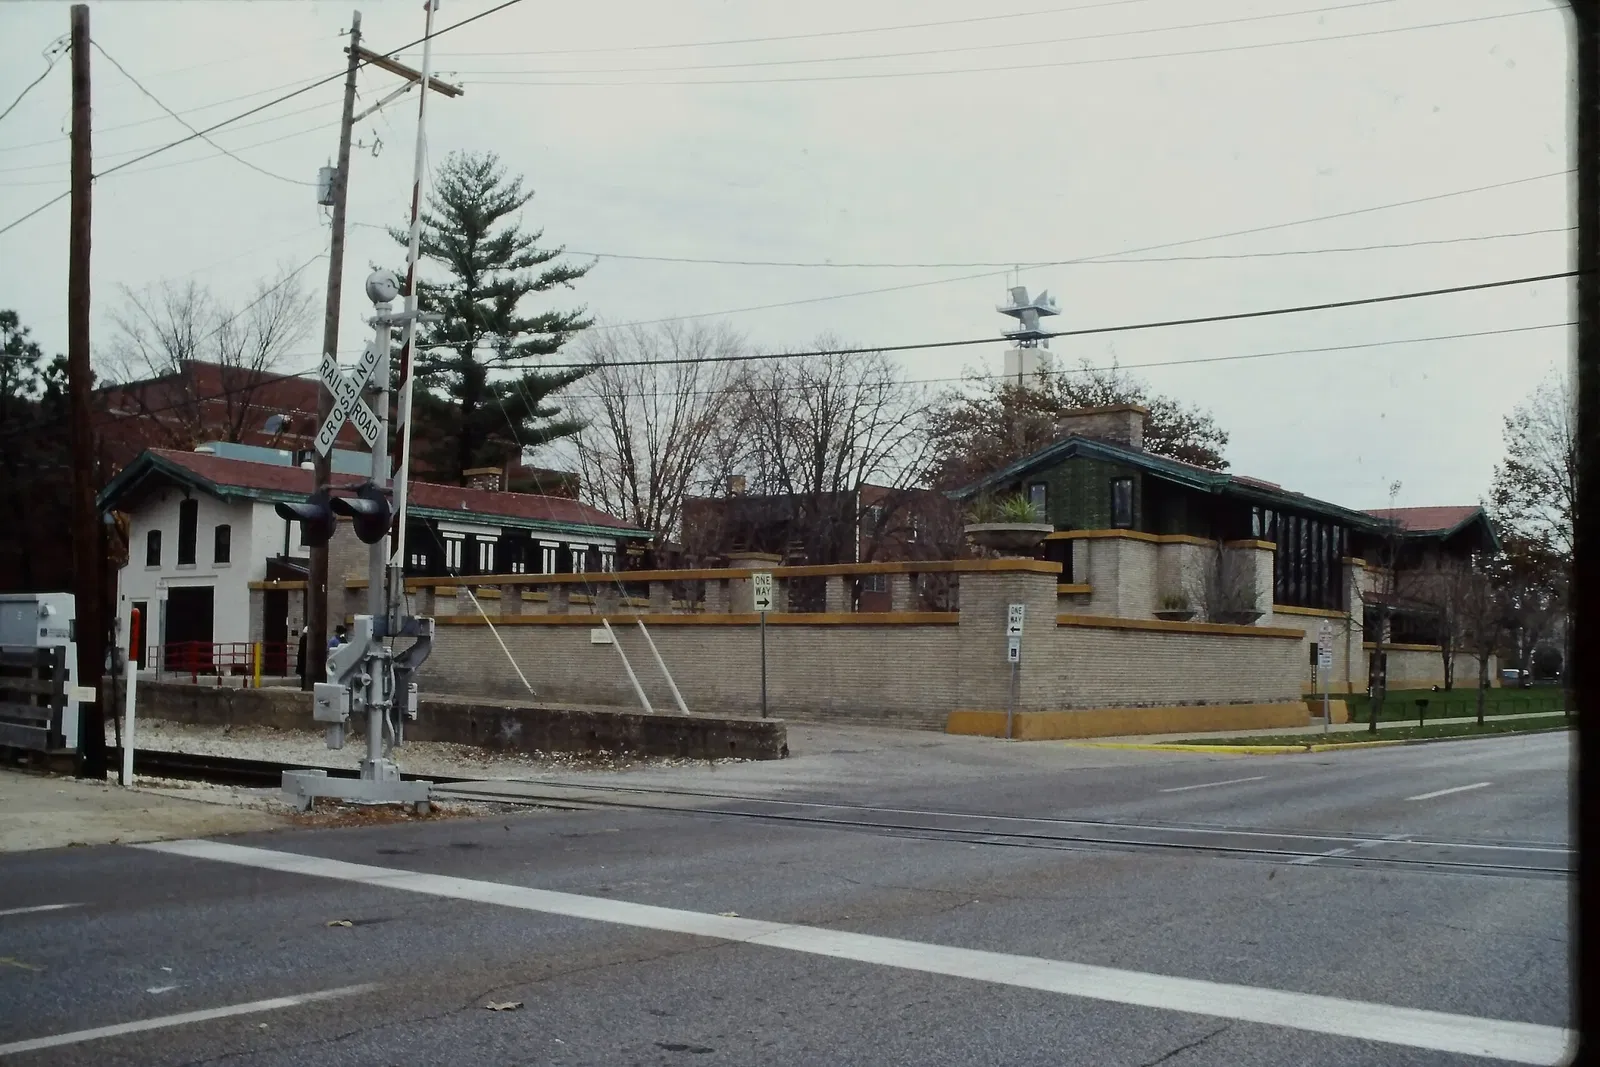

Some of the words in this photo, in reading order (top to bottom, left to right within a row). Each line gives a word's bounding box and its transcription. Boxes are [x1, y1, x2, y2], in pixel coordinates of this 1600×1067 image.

[319, 359, 343, 396] RAIL
[351, 402, 379, 441] ROAD
[320, 350, 375, 446] CROSSING
[755, 575, 771, 586] ONE
[755, 586, 771, 596] WAY
[1010, 606, 1022, 615] ONE
[1010, 616, 1021, 624] WAY
